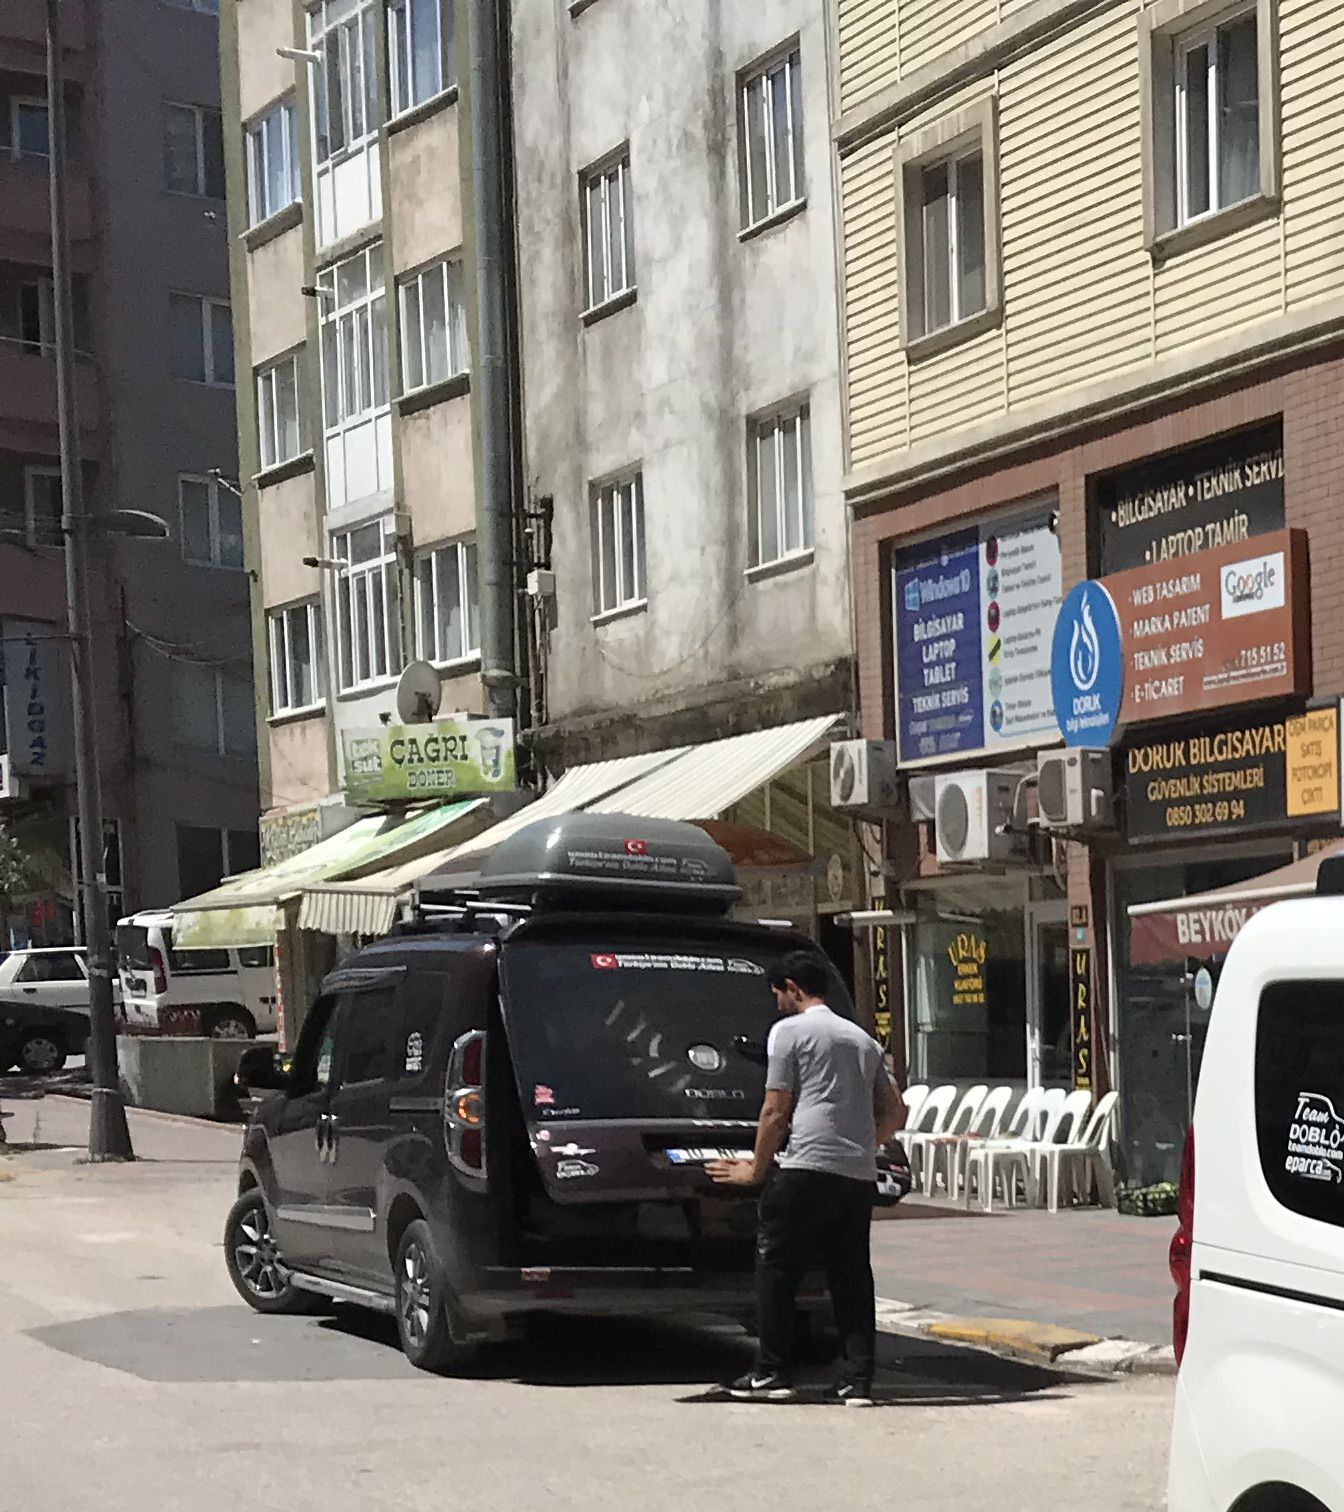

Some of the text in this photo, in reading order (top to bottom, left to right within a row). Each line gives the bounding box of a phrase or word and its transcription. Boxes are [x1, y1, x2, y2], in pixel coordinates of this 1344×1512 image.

[1152, 509, 1249, 564] LAPTOP TAMİR
[1132, 573, 1201, 606] WEB TASARIM
[1225, 561, 1276, 600] Google
[1133, 604, 1211, 639] MARKA PATENT
[922, 638, 957, 663] LAPTOP
[1134, 636, 1204, 671] TEKNİK SERVİS
[924, 662, 957, 687] TABLET
[941, 686, 970, 709] SERVİS
[1073, 692, 1102, 716] DORUK
[390, 733, 469, 768] ÇAĞRI
[1128, 740, 1186, 774] DORUK
[1147, 764, 1265, 802] GÜVENLİK SİSTEMLERİ
[1166, 804, 1193, 827] 0850
[1194, 802, 1214, 824] 302
[1230, 799, 1245, 819] 94
[1176, 904, 1248, 944] BEYKÖY
[1295, 1098, 1329, 1123] Team
